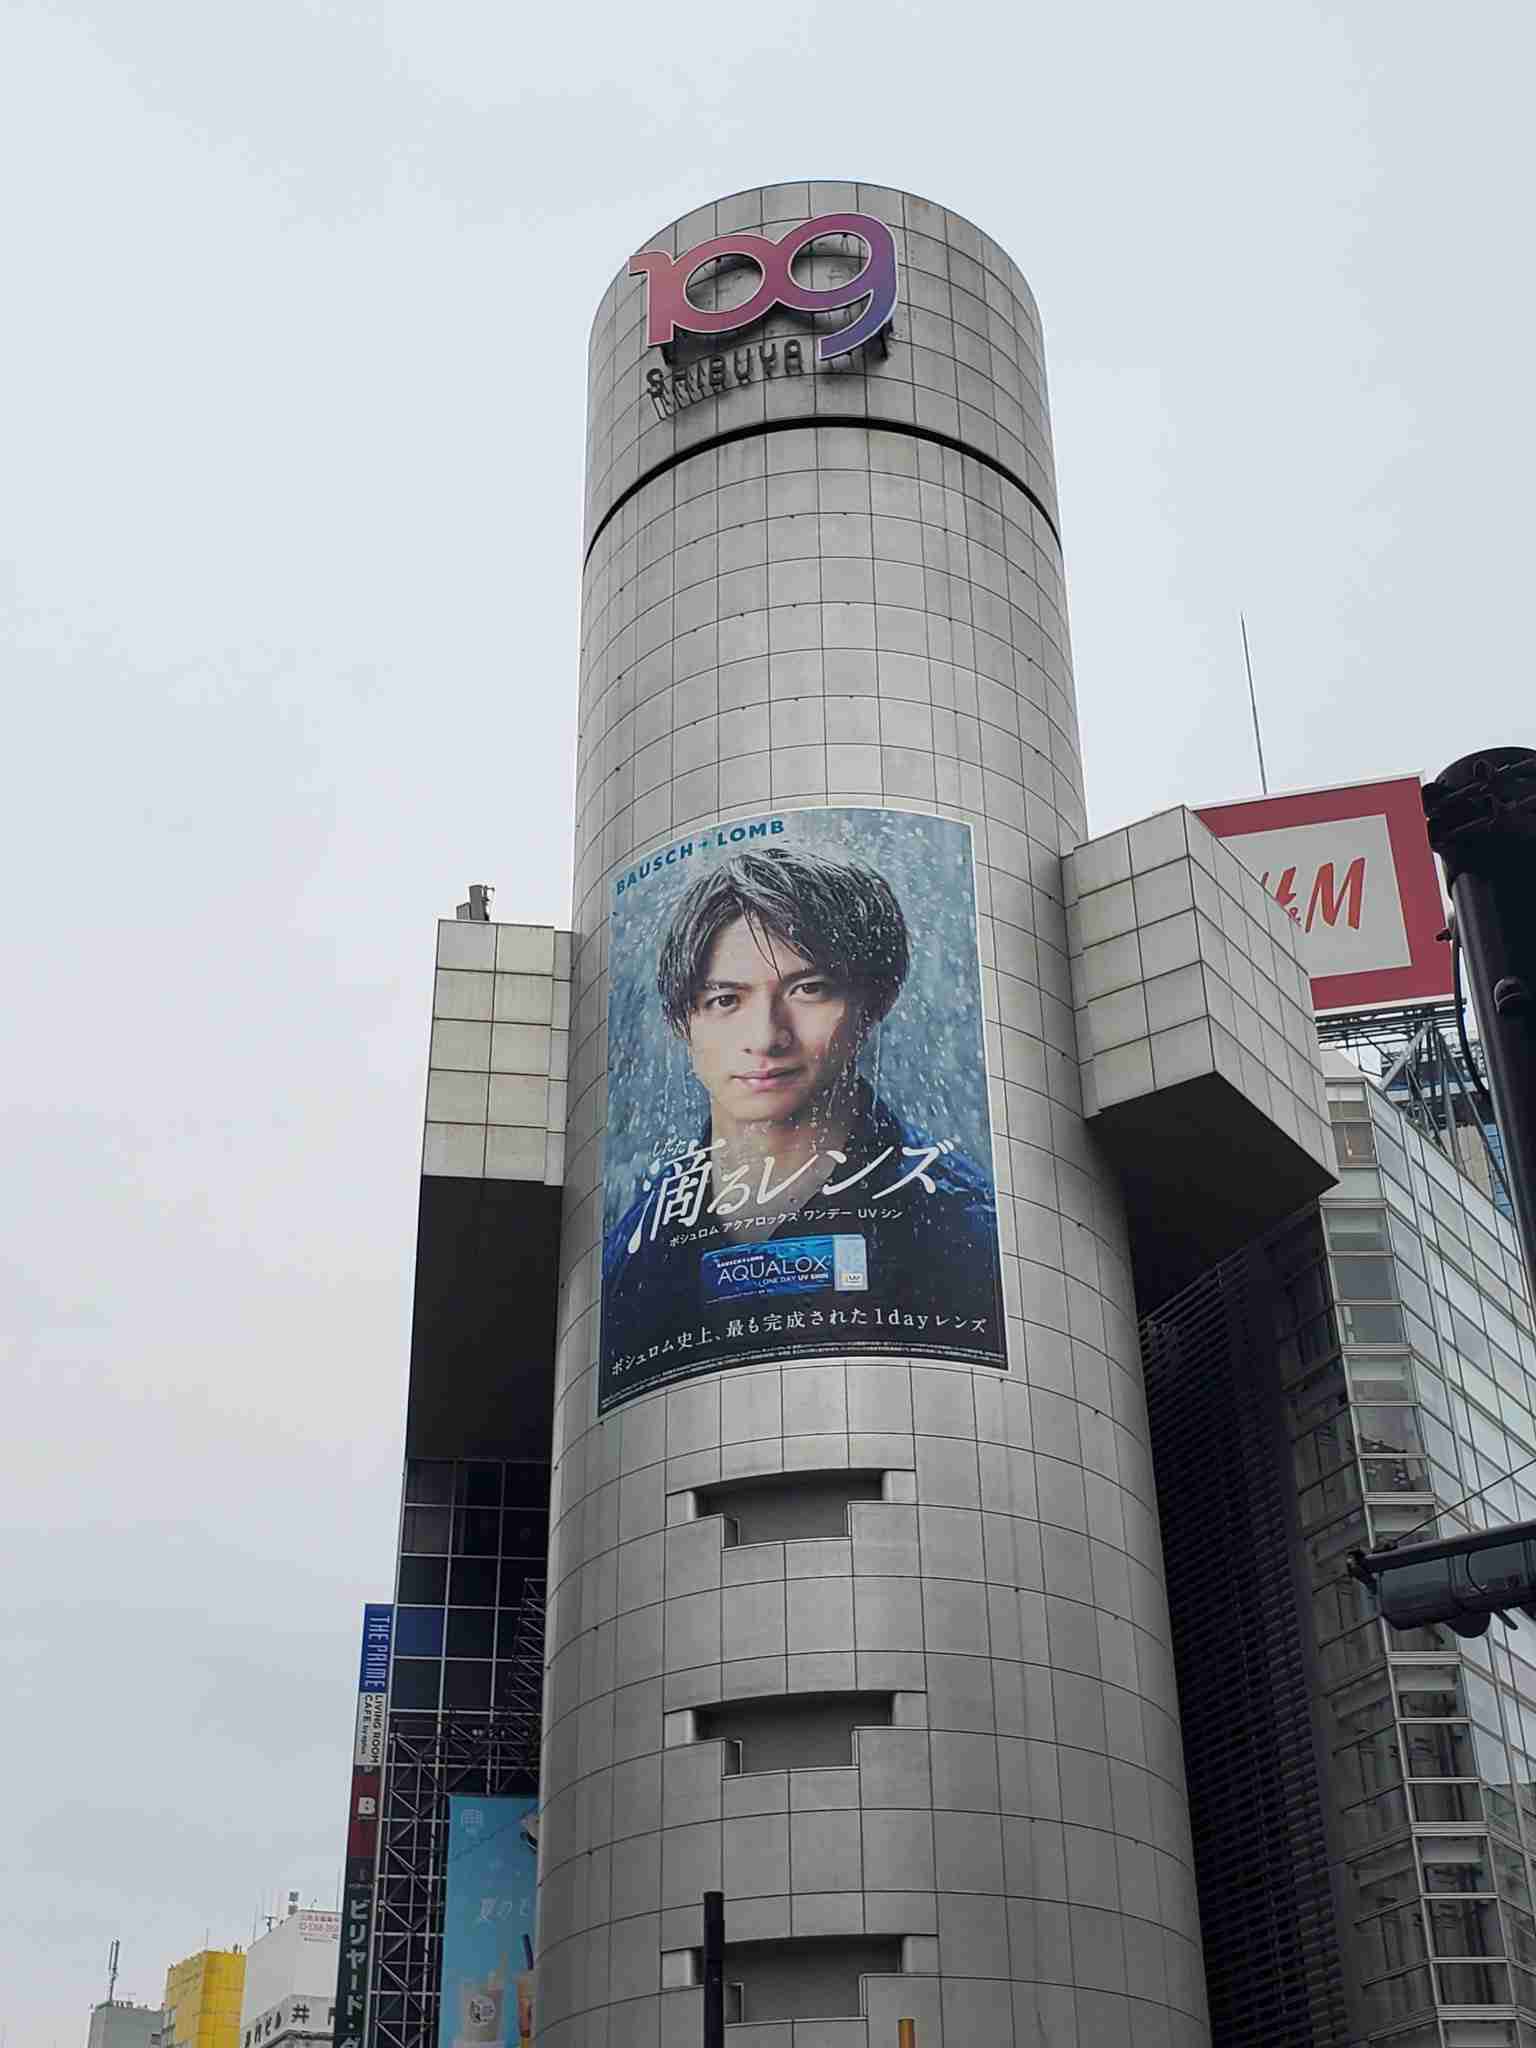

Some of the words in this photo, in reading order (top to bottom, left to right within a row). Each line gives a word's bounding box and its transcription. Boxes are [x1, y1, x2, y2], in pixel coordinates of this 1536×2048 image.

[627, 212, 898, 361] 109
[646, 338, 803, 398] SHIBUYA
[616, 843, 694, 896] BAUSCH
[717, 820, 784, 848] LOMB
[627, 1138, 955, 1255] 滴るレンズ
[669, 1227, 720, 1248] ボシュロム
[722, 1211, 800, 1233] アクアロックス
[803, 1207, 852, 1221] ワンデー
[858, 1208, 877, 1219] UV
[881, 1208, 903, 1220] シン
[717, 1255, 829, 1286] AQUALOX
[367, 1615, 391, 1641] THE
[364, 1643, 388, 1688] PRIME
[363, 1694, 373, 1722] CAFE
[373, 1694, 384, 1729] LIVING
[370, 1731, 382, 1763] ROOM
